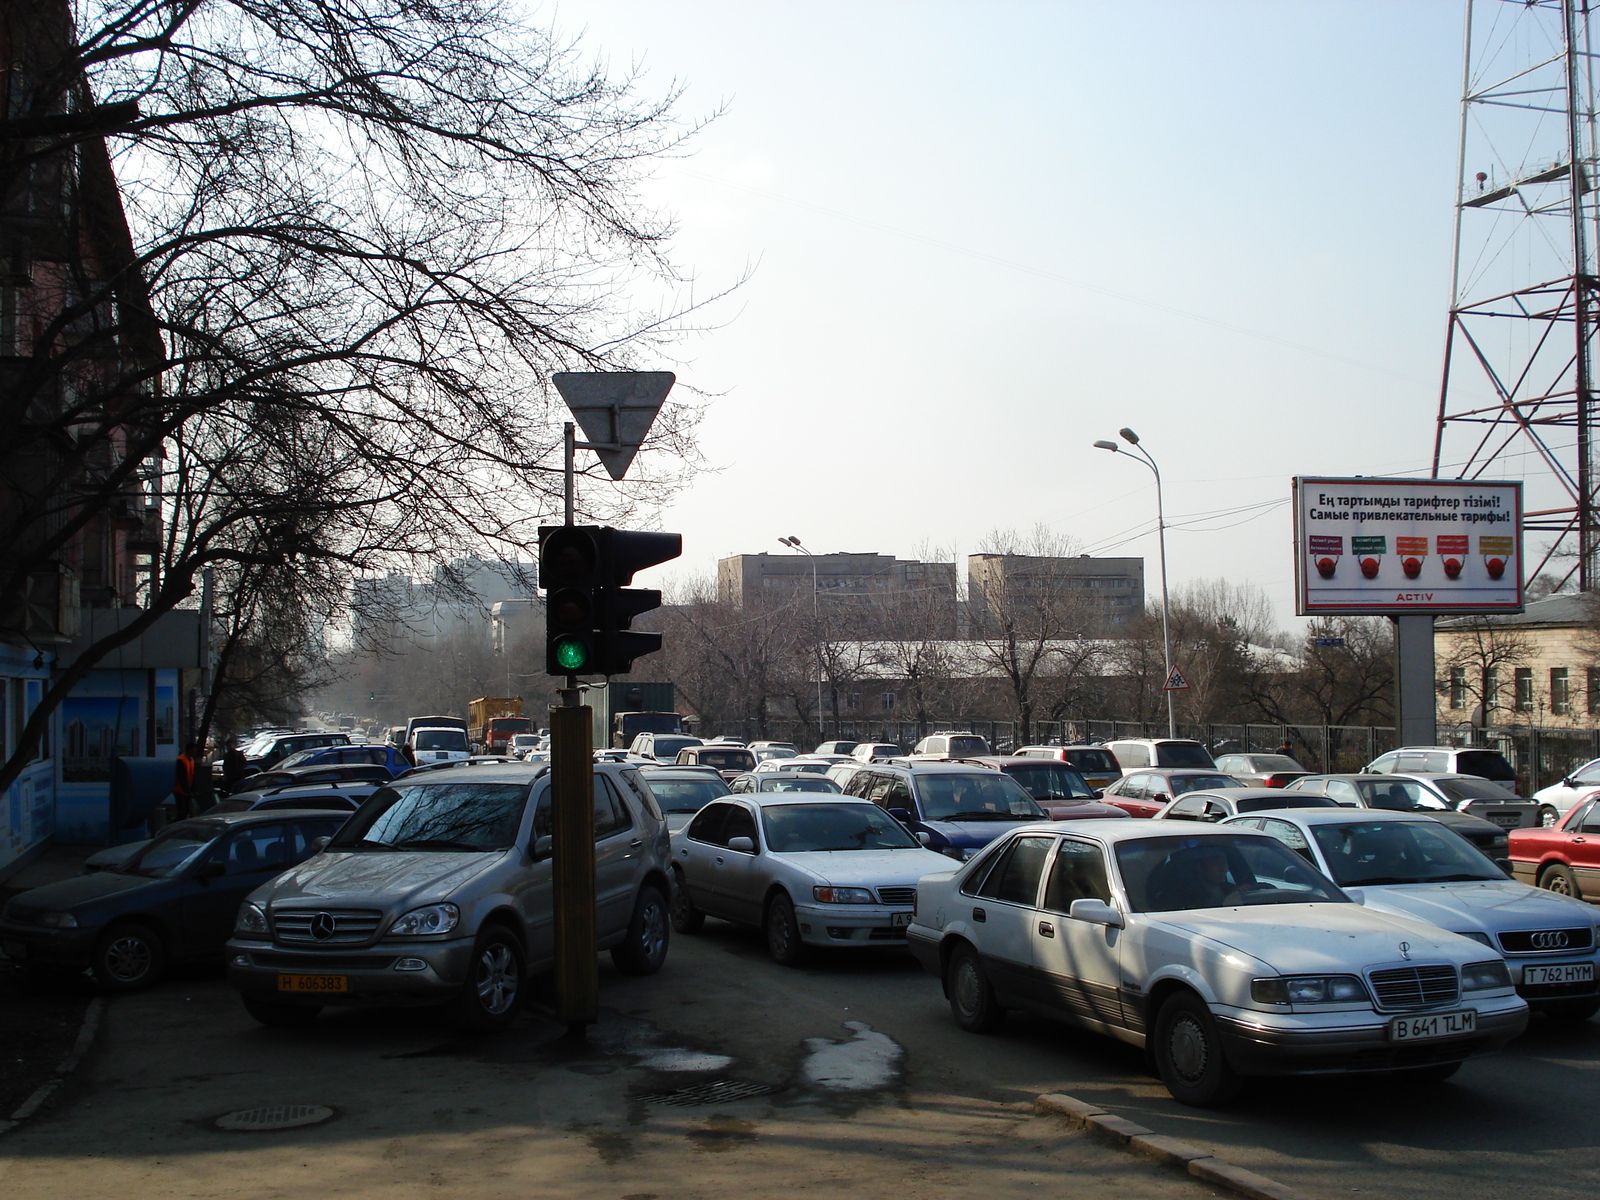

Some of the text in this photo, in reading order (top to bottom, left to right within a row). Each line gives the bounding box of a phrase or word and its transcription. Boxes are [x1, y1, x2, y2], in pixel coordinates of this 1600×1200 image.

[1319, 494, 1500, 510] Ең тартымды тарифтер тізімі!
[1310, 508, 1510, 524] Самые привлекательные тарифы!
[1396, 593, 1433, 601] ACTIV
[1528, 966, 1591, 983] T 762 HYM
[282, 976, 342, 990] H 606383
[1397, 1013, 1472, 1038] B 641 TLM
